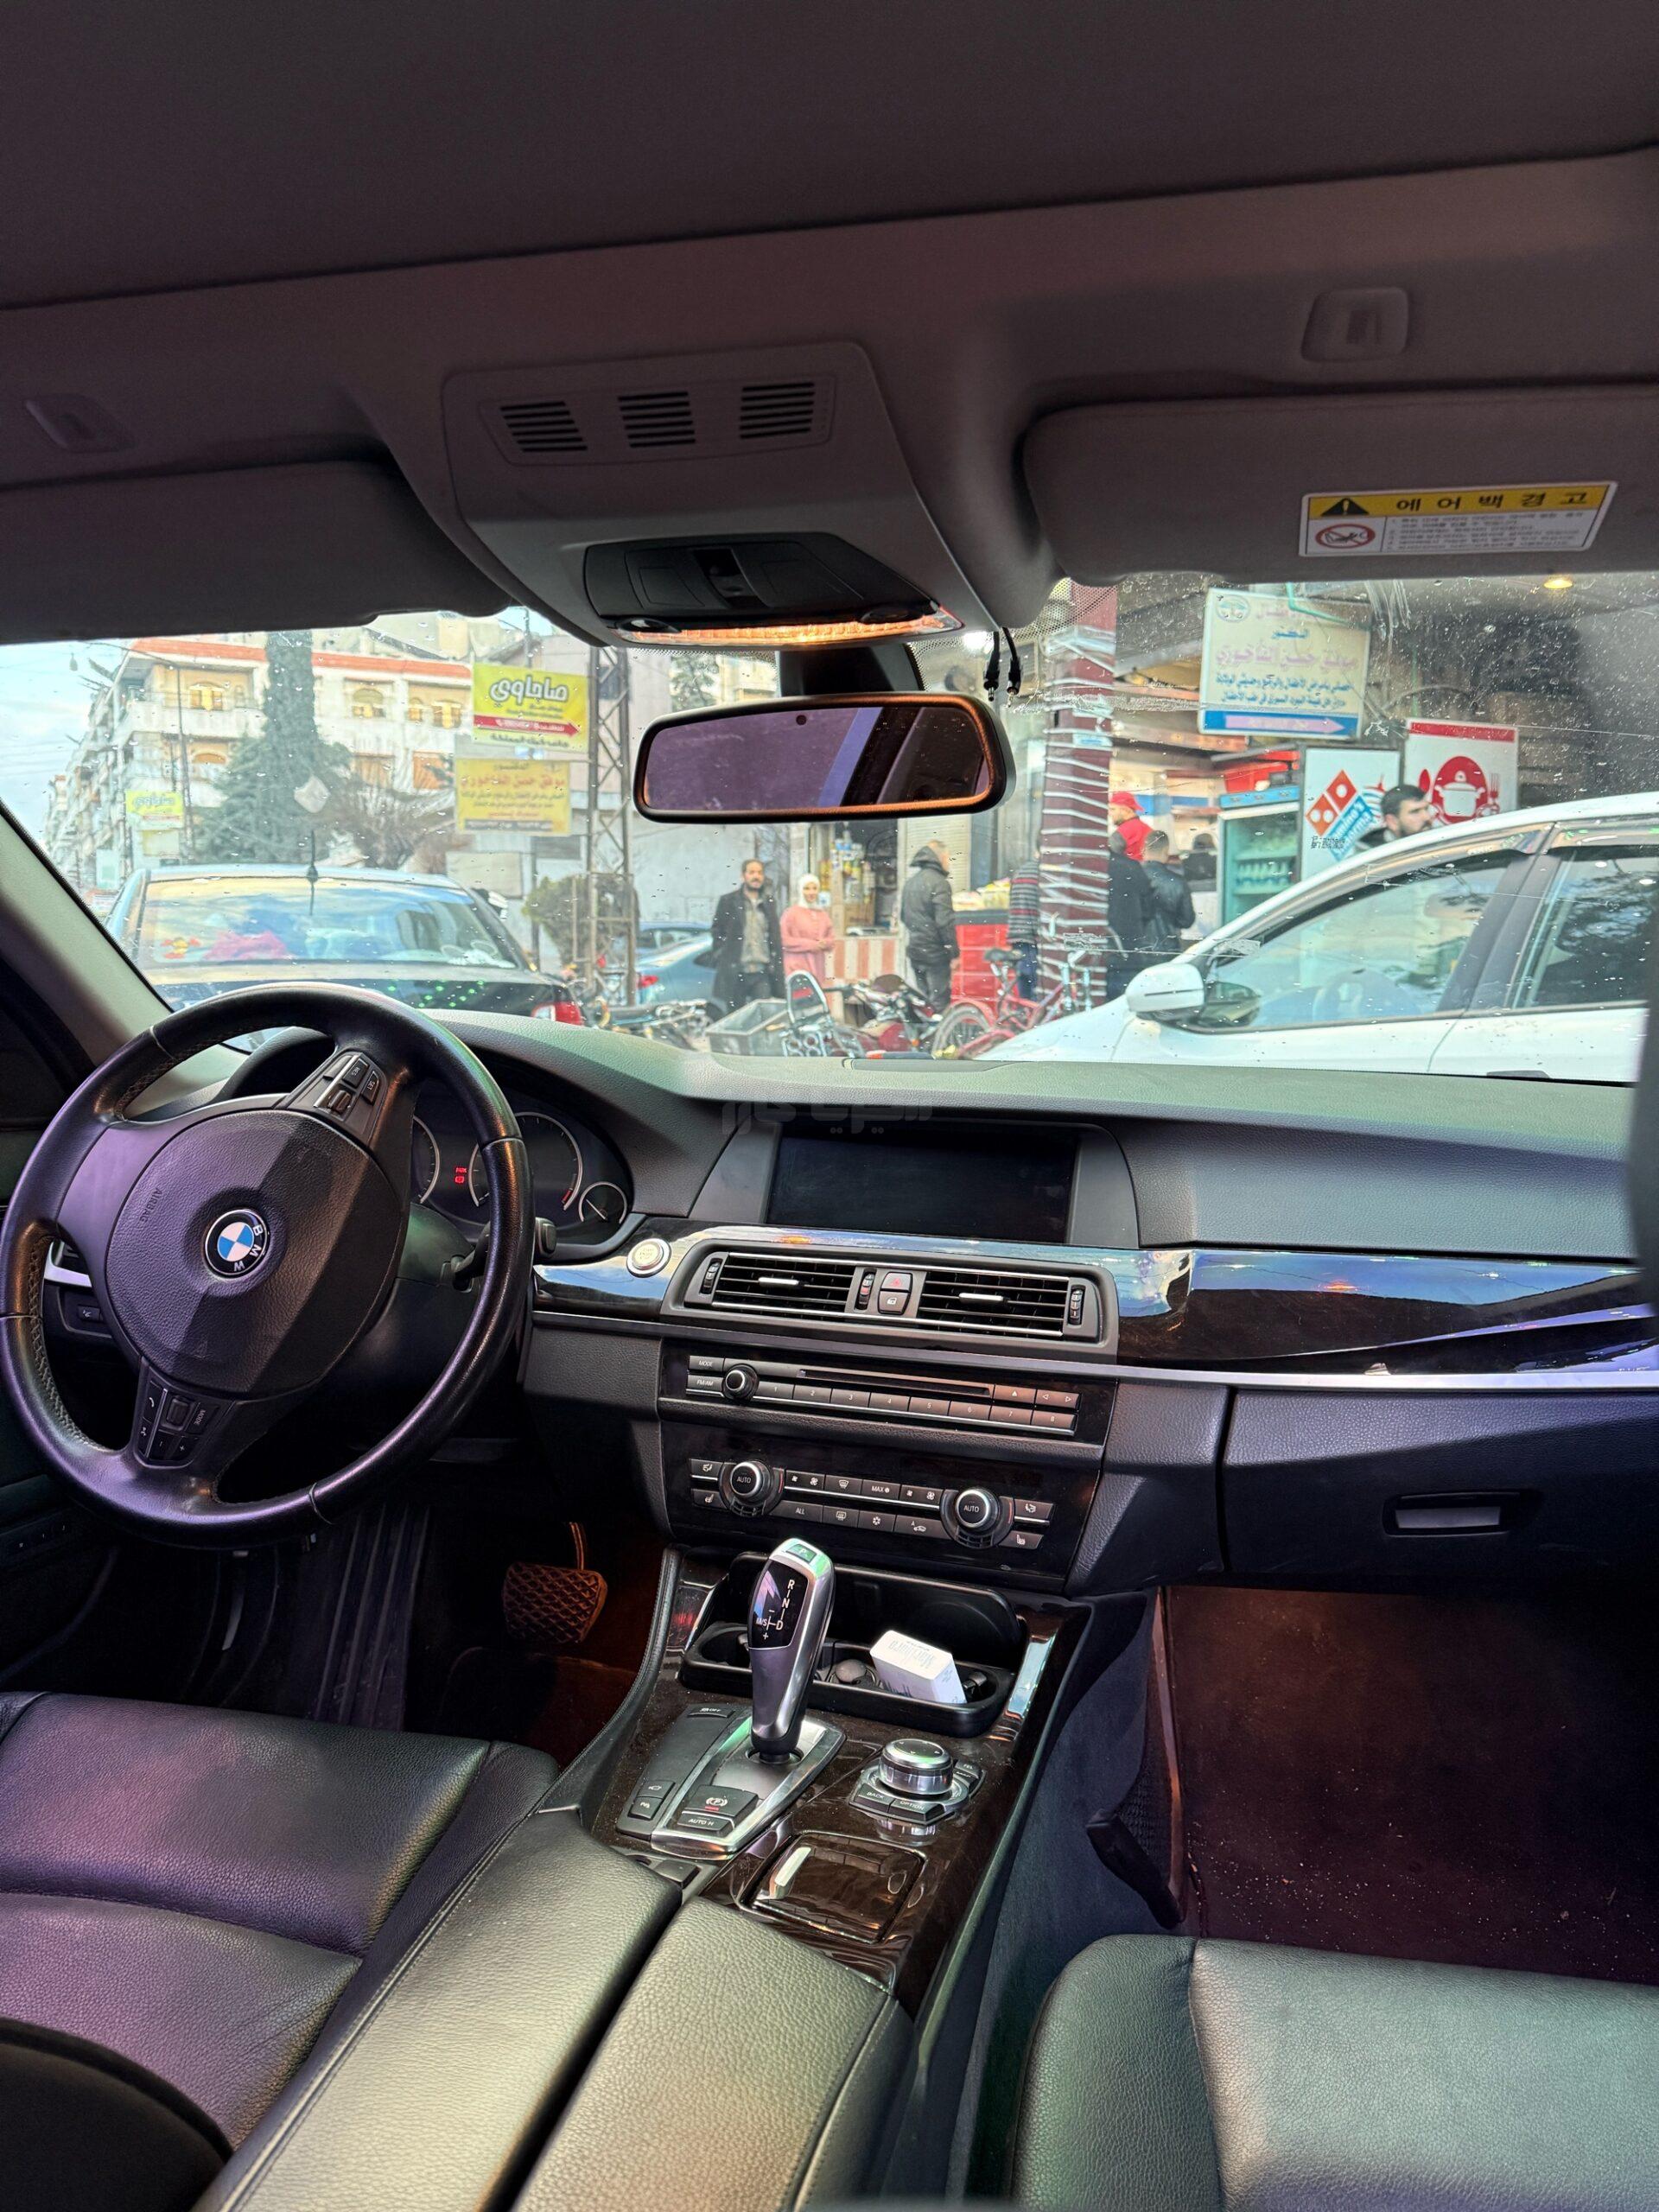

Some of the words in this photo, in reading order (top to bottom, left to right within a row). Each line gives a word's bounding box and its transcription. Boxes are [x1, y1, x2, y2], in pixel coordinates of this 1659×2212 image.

[139, 1187, 163, 1224] AIRBAG
[232, 1224, 264, 1273] BMW
[963, 1504, 980, 1513] AUTO
[787, 1580, 795, 1590] R
[781, 1598, 790, 1608] N
[775, 1620, 784, 1630] D
[899, 1801, 925, 1811] OPTION
